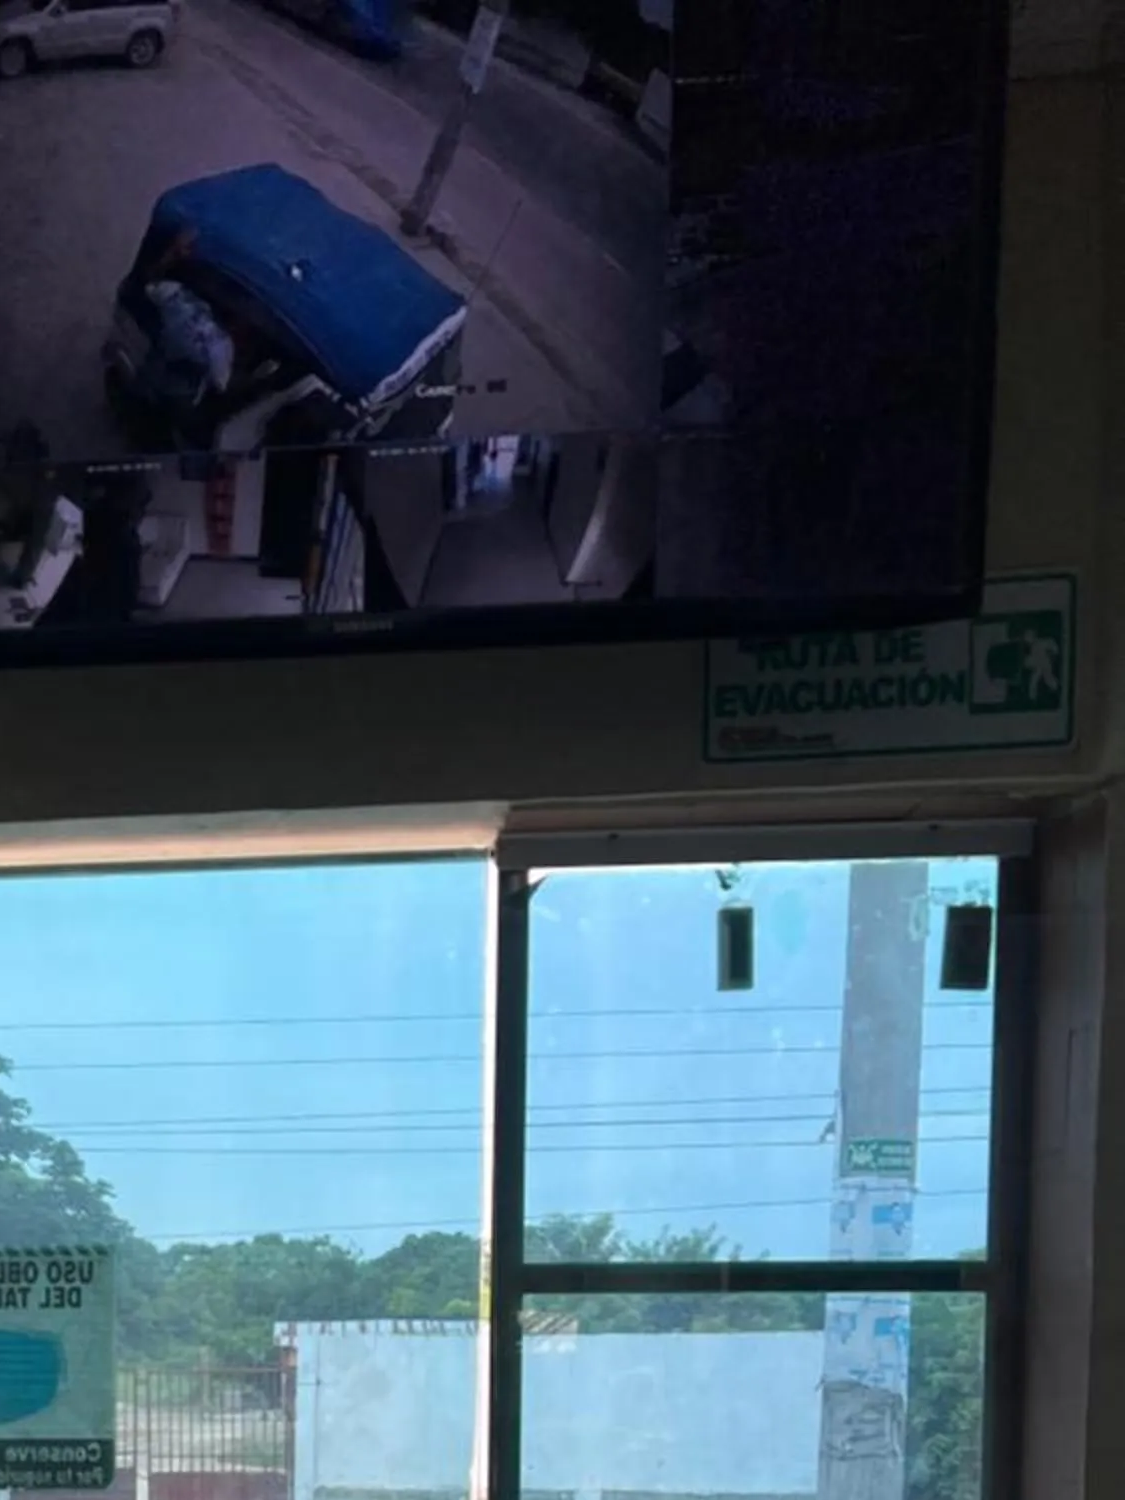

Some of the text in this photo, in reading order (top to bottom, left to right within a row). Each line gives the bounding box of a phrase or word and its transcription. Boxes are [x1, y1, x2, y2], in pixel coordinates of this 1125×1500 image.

[756, 630, 924, 671] RUTA DE
[714, 667, 966, 718] EVACUACIÓN
